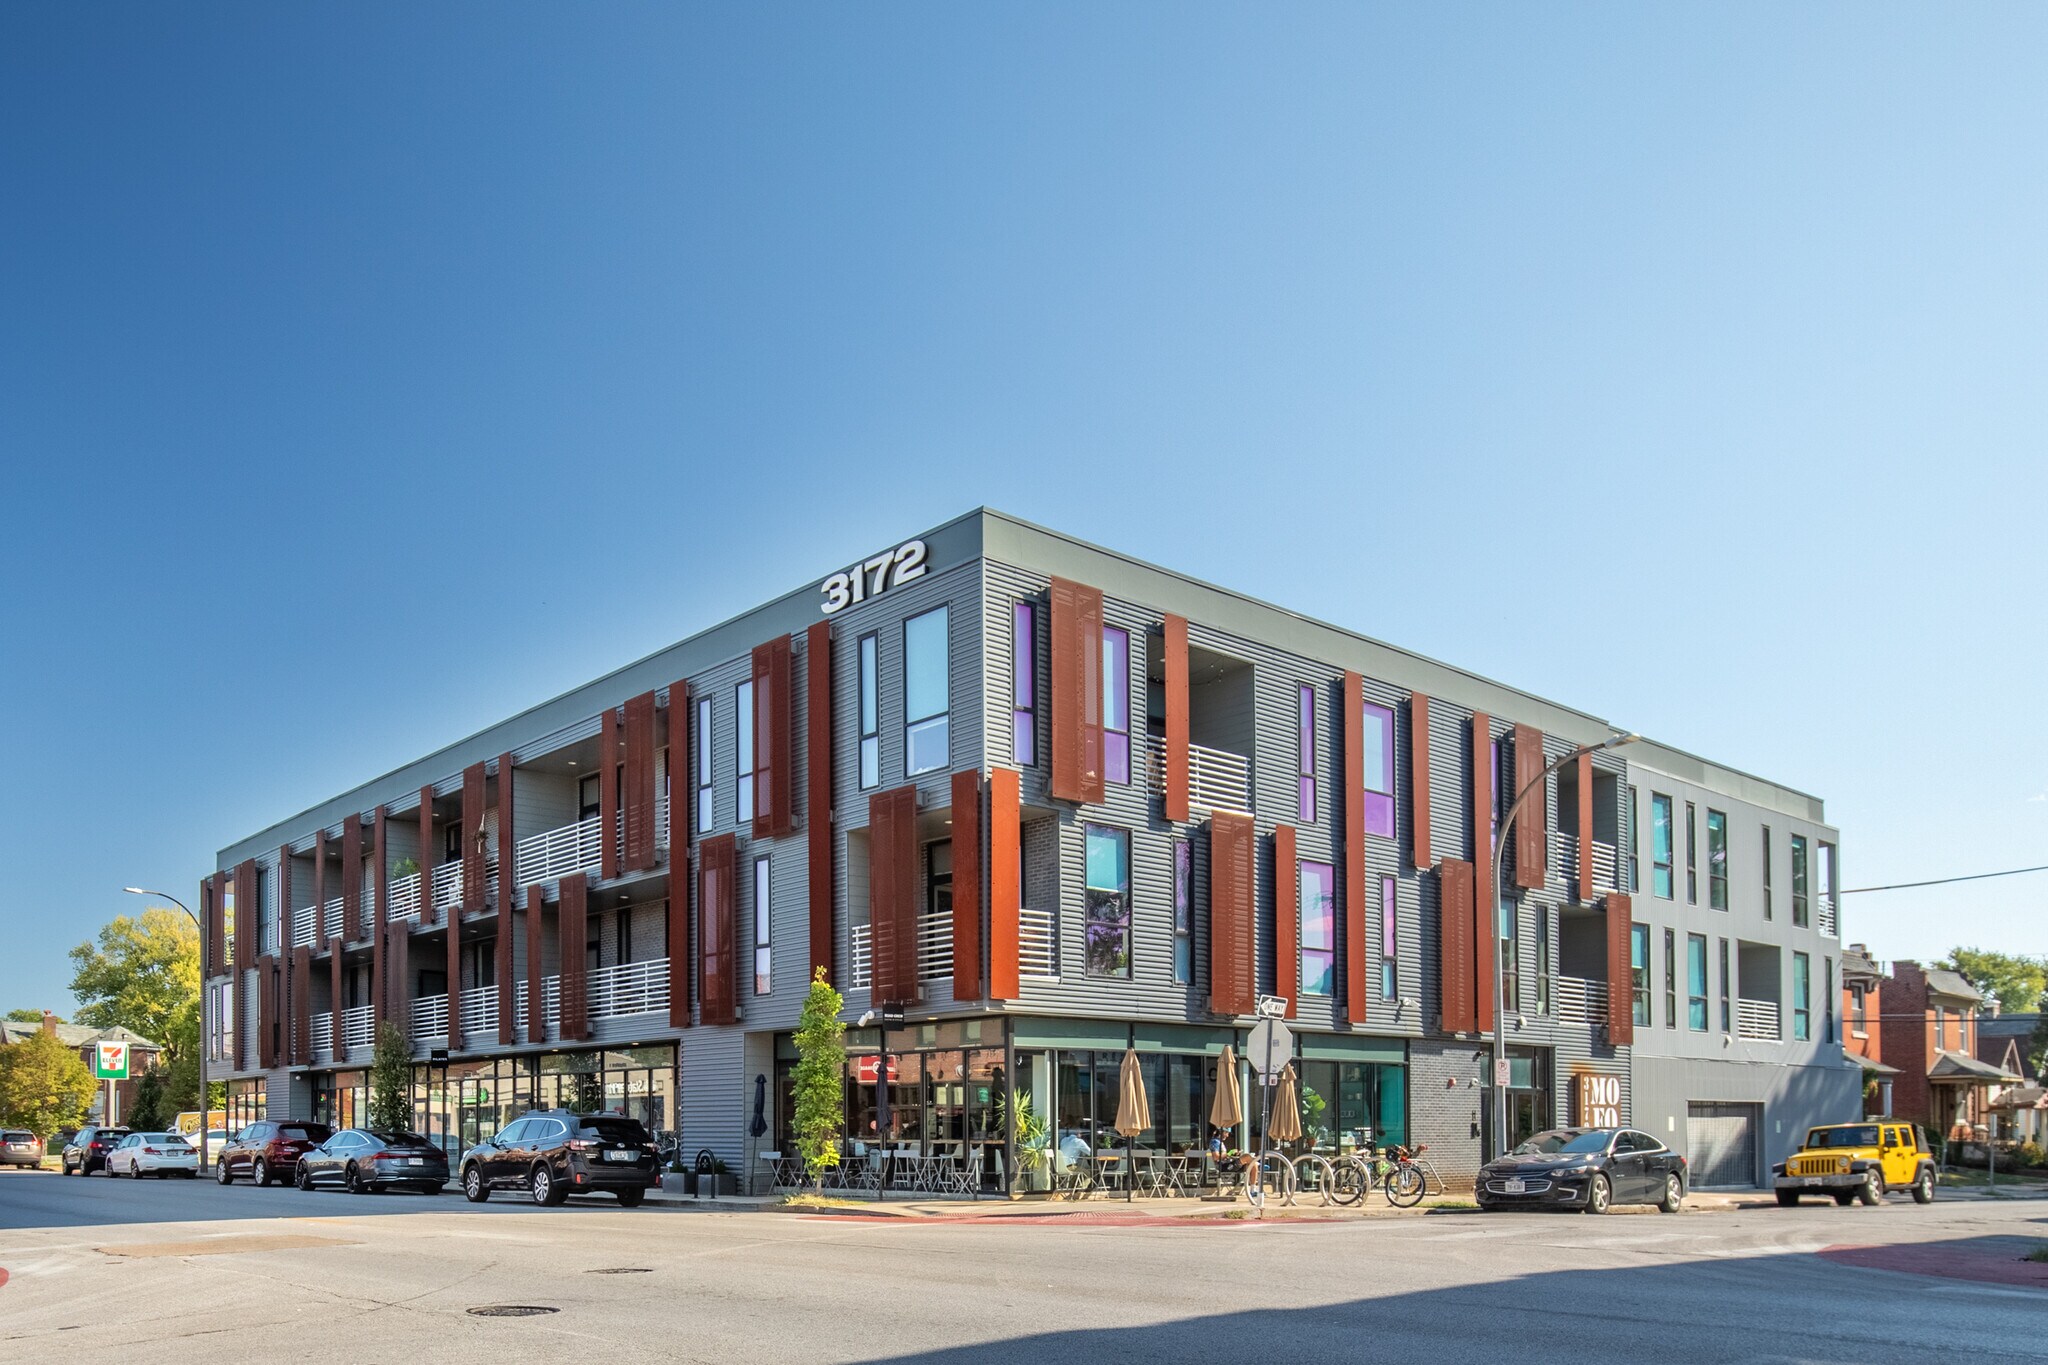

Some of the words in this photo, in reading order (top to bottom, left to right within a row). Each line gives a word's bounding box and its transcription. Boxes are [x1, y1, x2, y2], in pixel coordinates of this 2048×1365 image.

[820, 540, 926, 614] 3172
[1264, 1002, 1274, 1011] ONE
[1275, 1003, 1285, 1013] WAY
[103, 1047, 122, 1070] 7
[1590, 1077, 1620, 1106] MO
